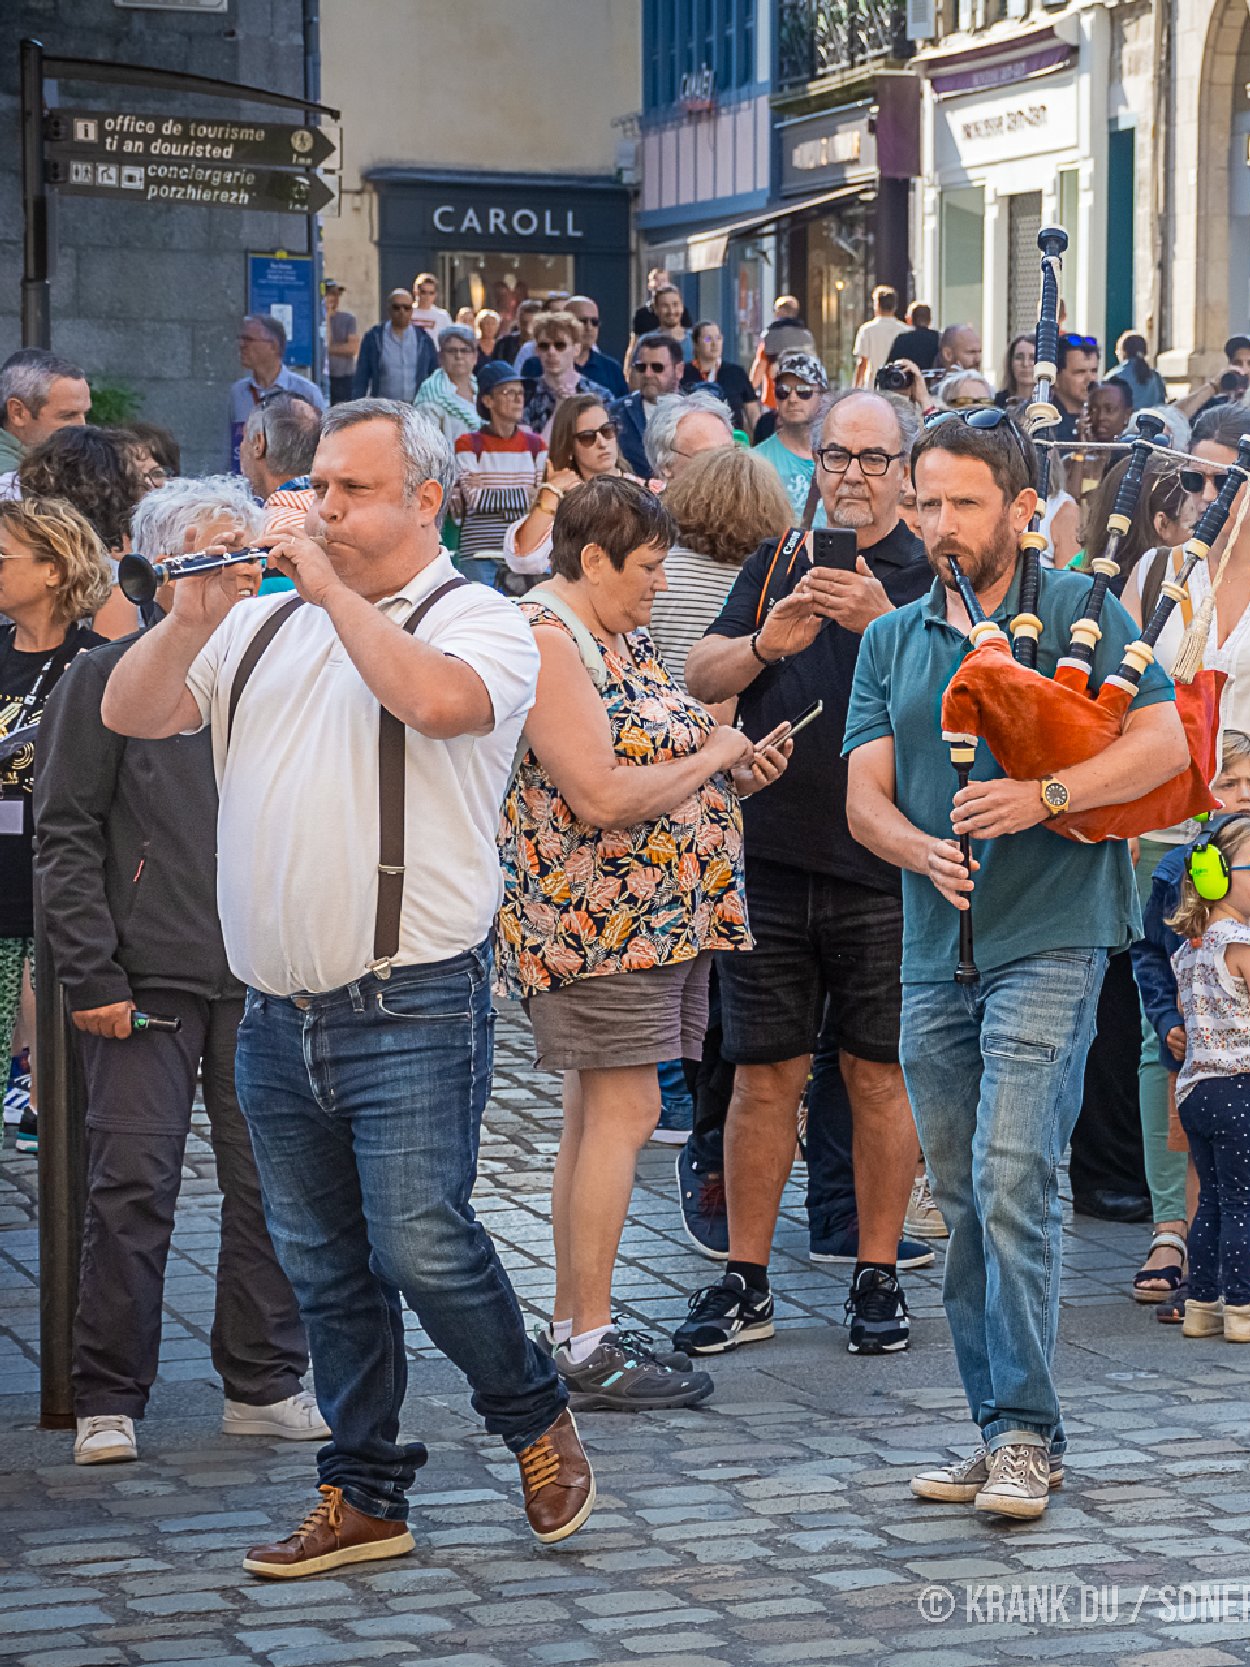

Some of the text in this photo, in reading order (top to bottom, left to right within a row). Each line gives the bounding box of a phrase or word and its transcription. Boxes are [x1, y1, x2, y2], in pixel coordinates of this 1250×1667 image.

[104, 115, 265, 141] office de tourisme
[105, 135, 234, 159] ti an douristed
[147, 164, 256, 185] conciergerie
[147, 184, 250, 205] porzhierezh
[433, 205, 584, 237] CAROLL
